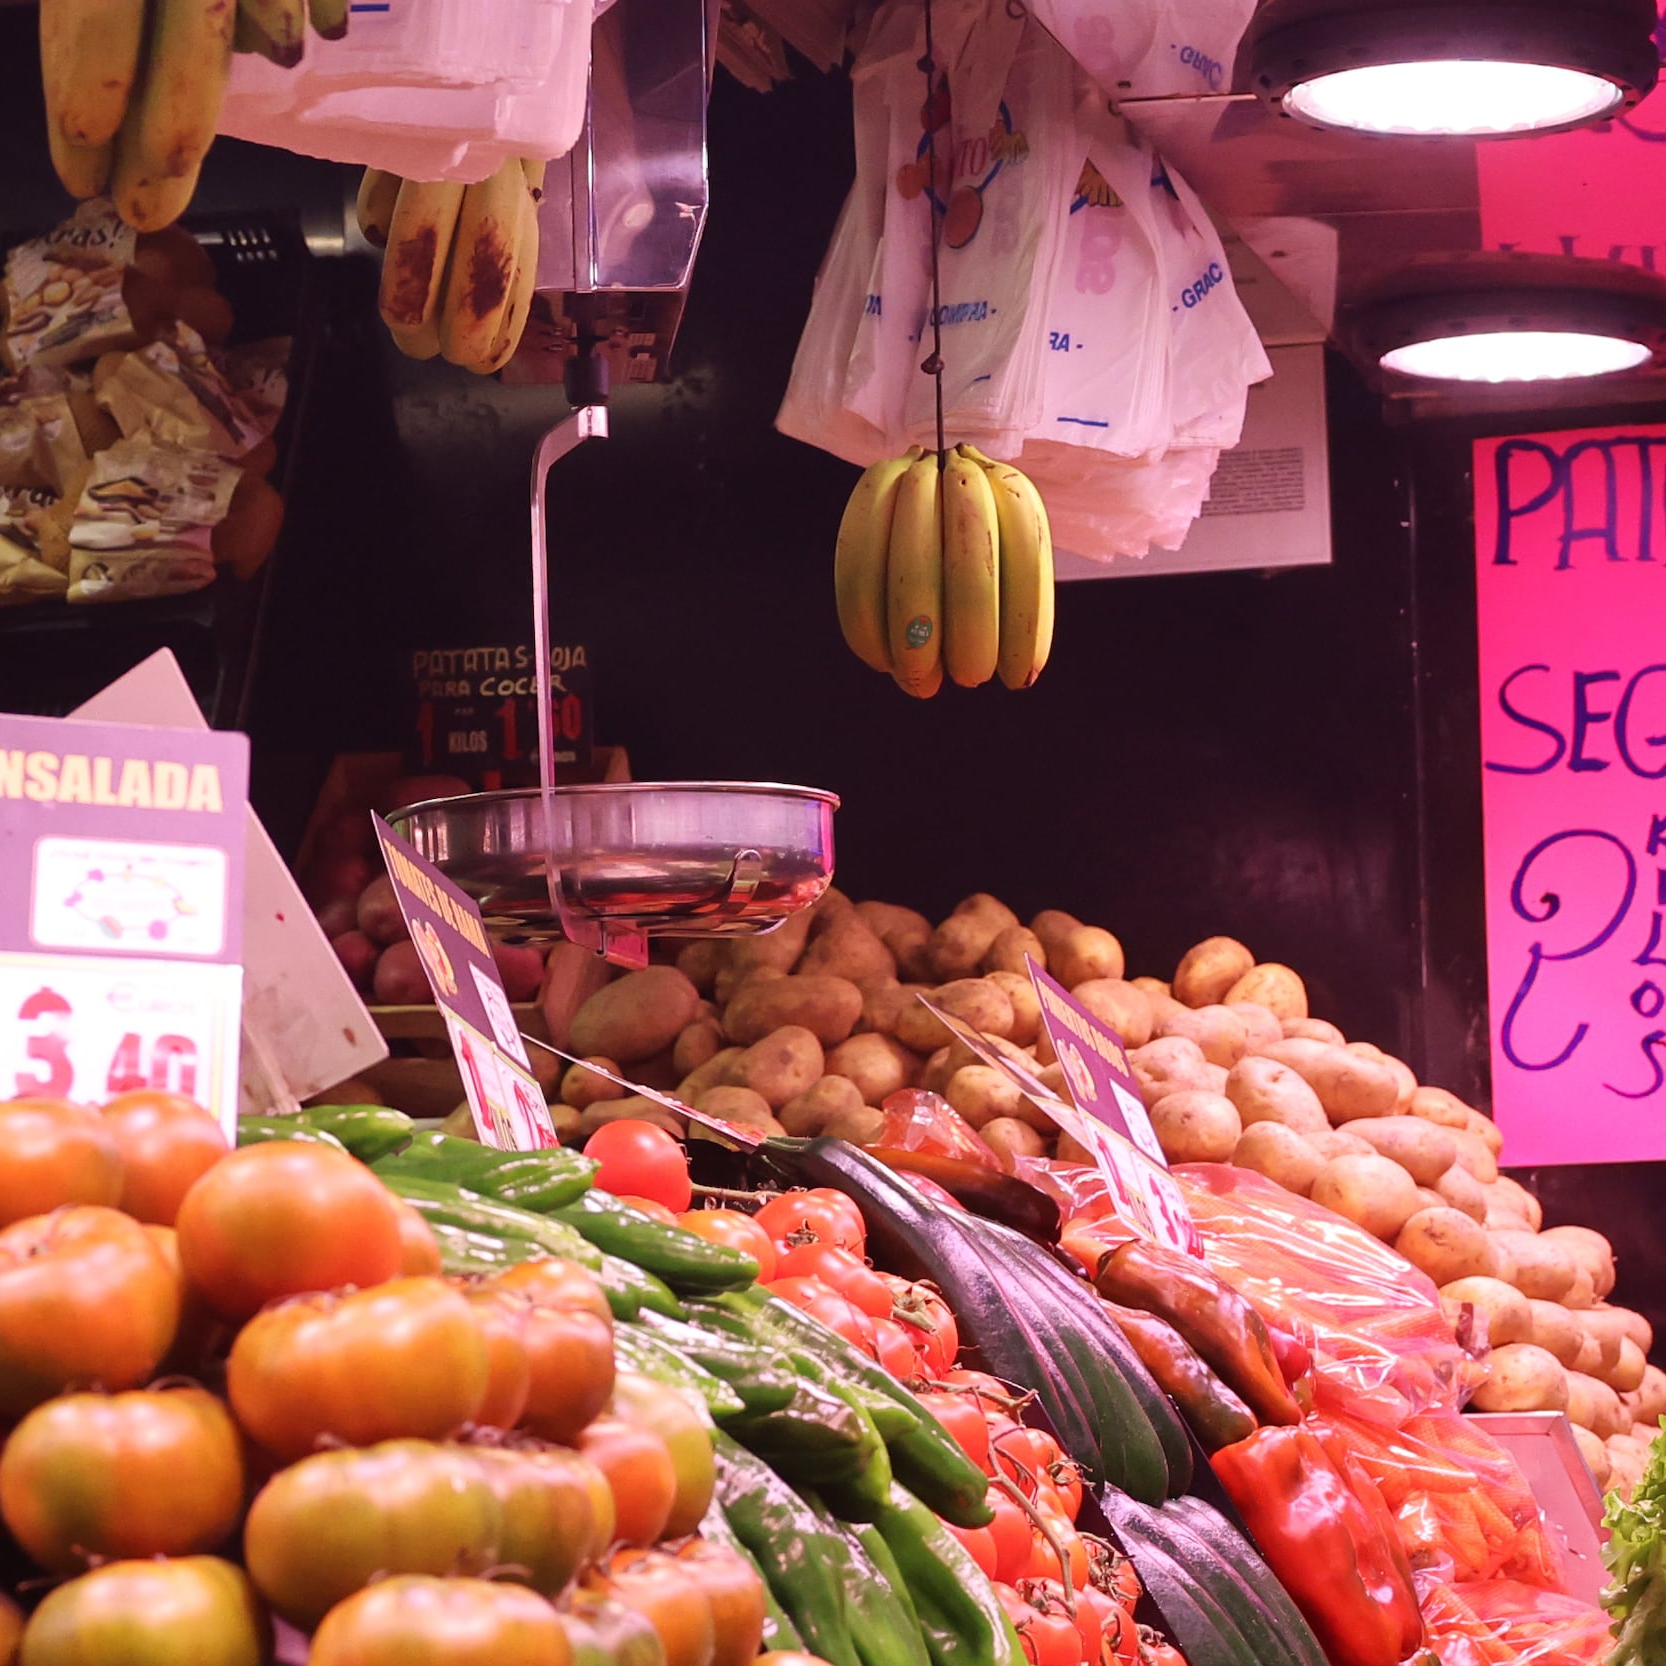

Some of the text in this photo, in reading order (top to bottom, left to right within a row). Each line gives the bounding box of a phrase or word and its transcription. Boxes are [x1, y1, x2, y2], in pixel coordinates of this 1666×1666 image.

[413, 645, 587, 678] PATATAS OJA
[419, 679, 471, 698] PARA
